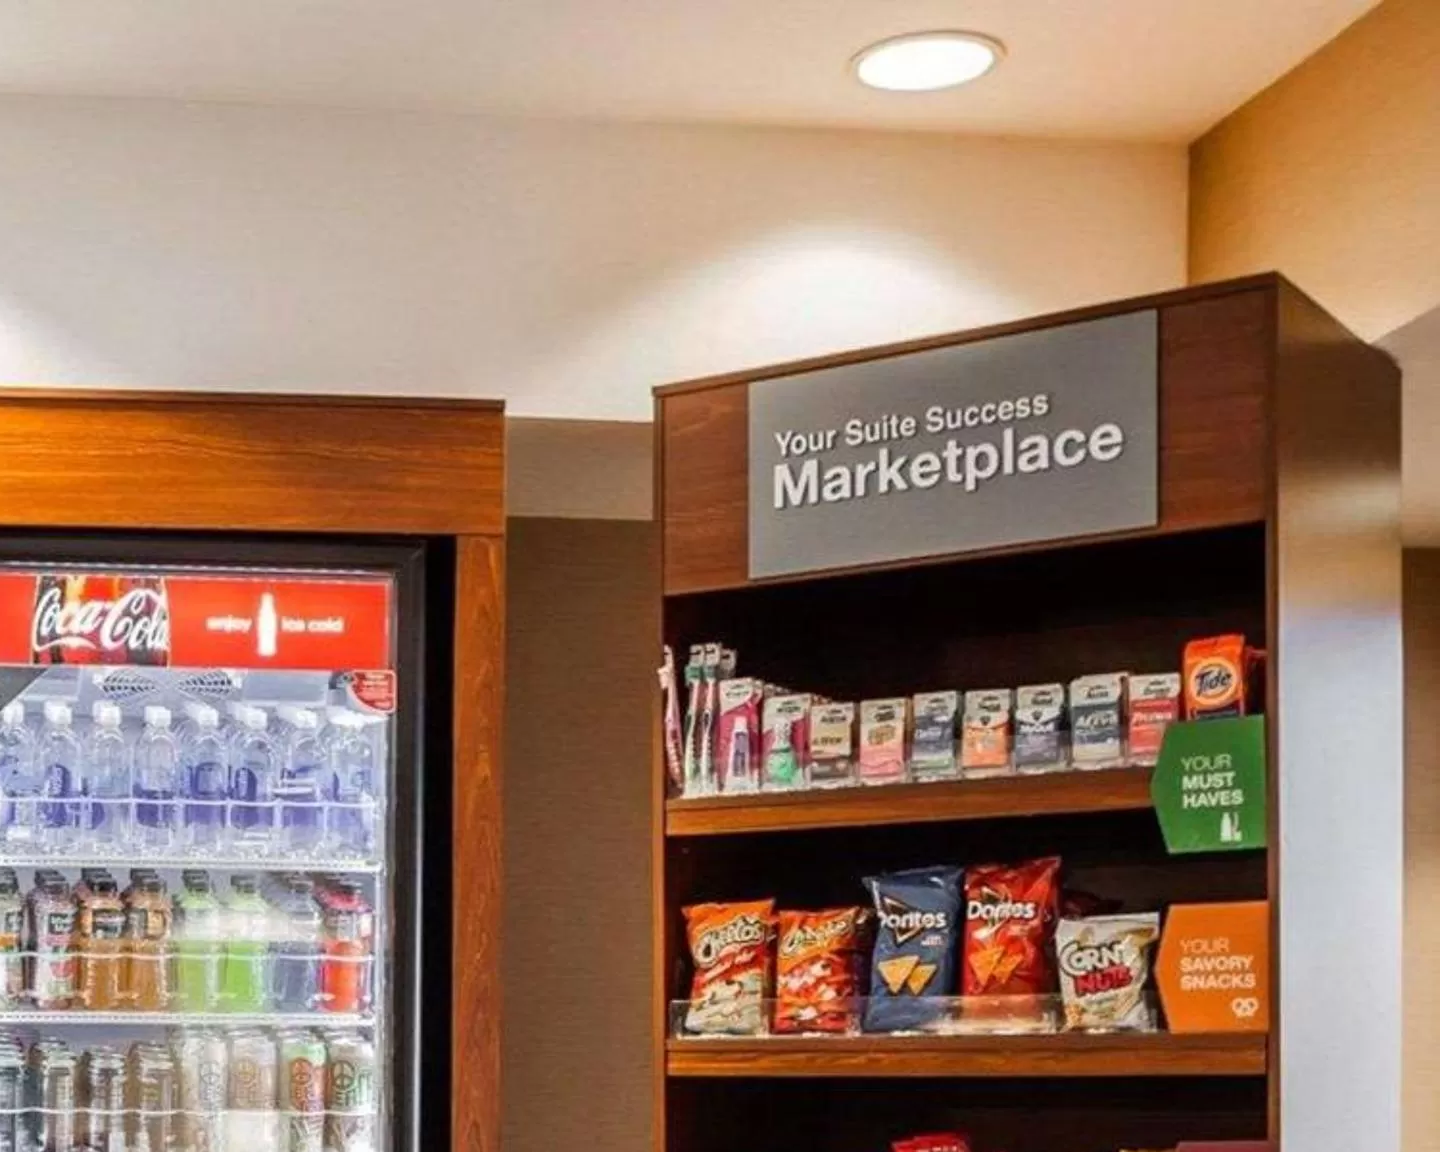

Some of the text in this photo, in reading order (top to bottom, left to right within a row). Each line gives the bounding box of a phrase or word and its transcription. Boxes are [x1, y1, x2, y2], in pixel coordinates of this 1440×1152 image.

[774, 394, 1050, 458] Your Suite Success
[772, 422, 1124, 510] Marketplace
[1195, 671, 1232, 697] Tide
[1181, 753, 1232, 771] YOUR
[1181, 771, 1236, 790] MUST
[1183, 788, 1245, 809] HAVES
[967, 901, 1036, 920] Doritos
[1179, 937, 1230, 953] YOUR
[1179, 955, 1255, 973] SAVORY
[1179, 973, 1257, 990] SNACKS
